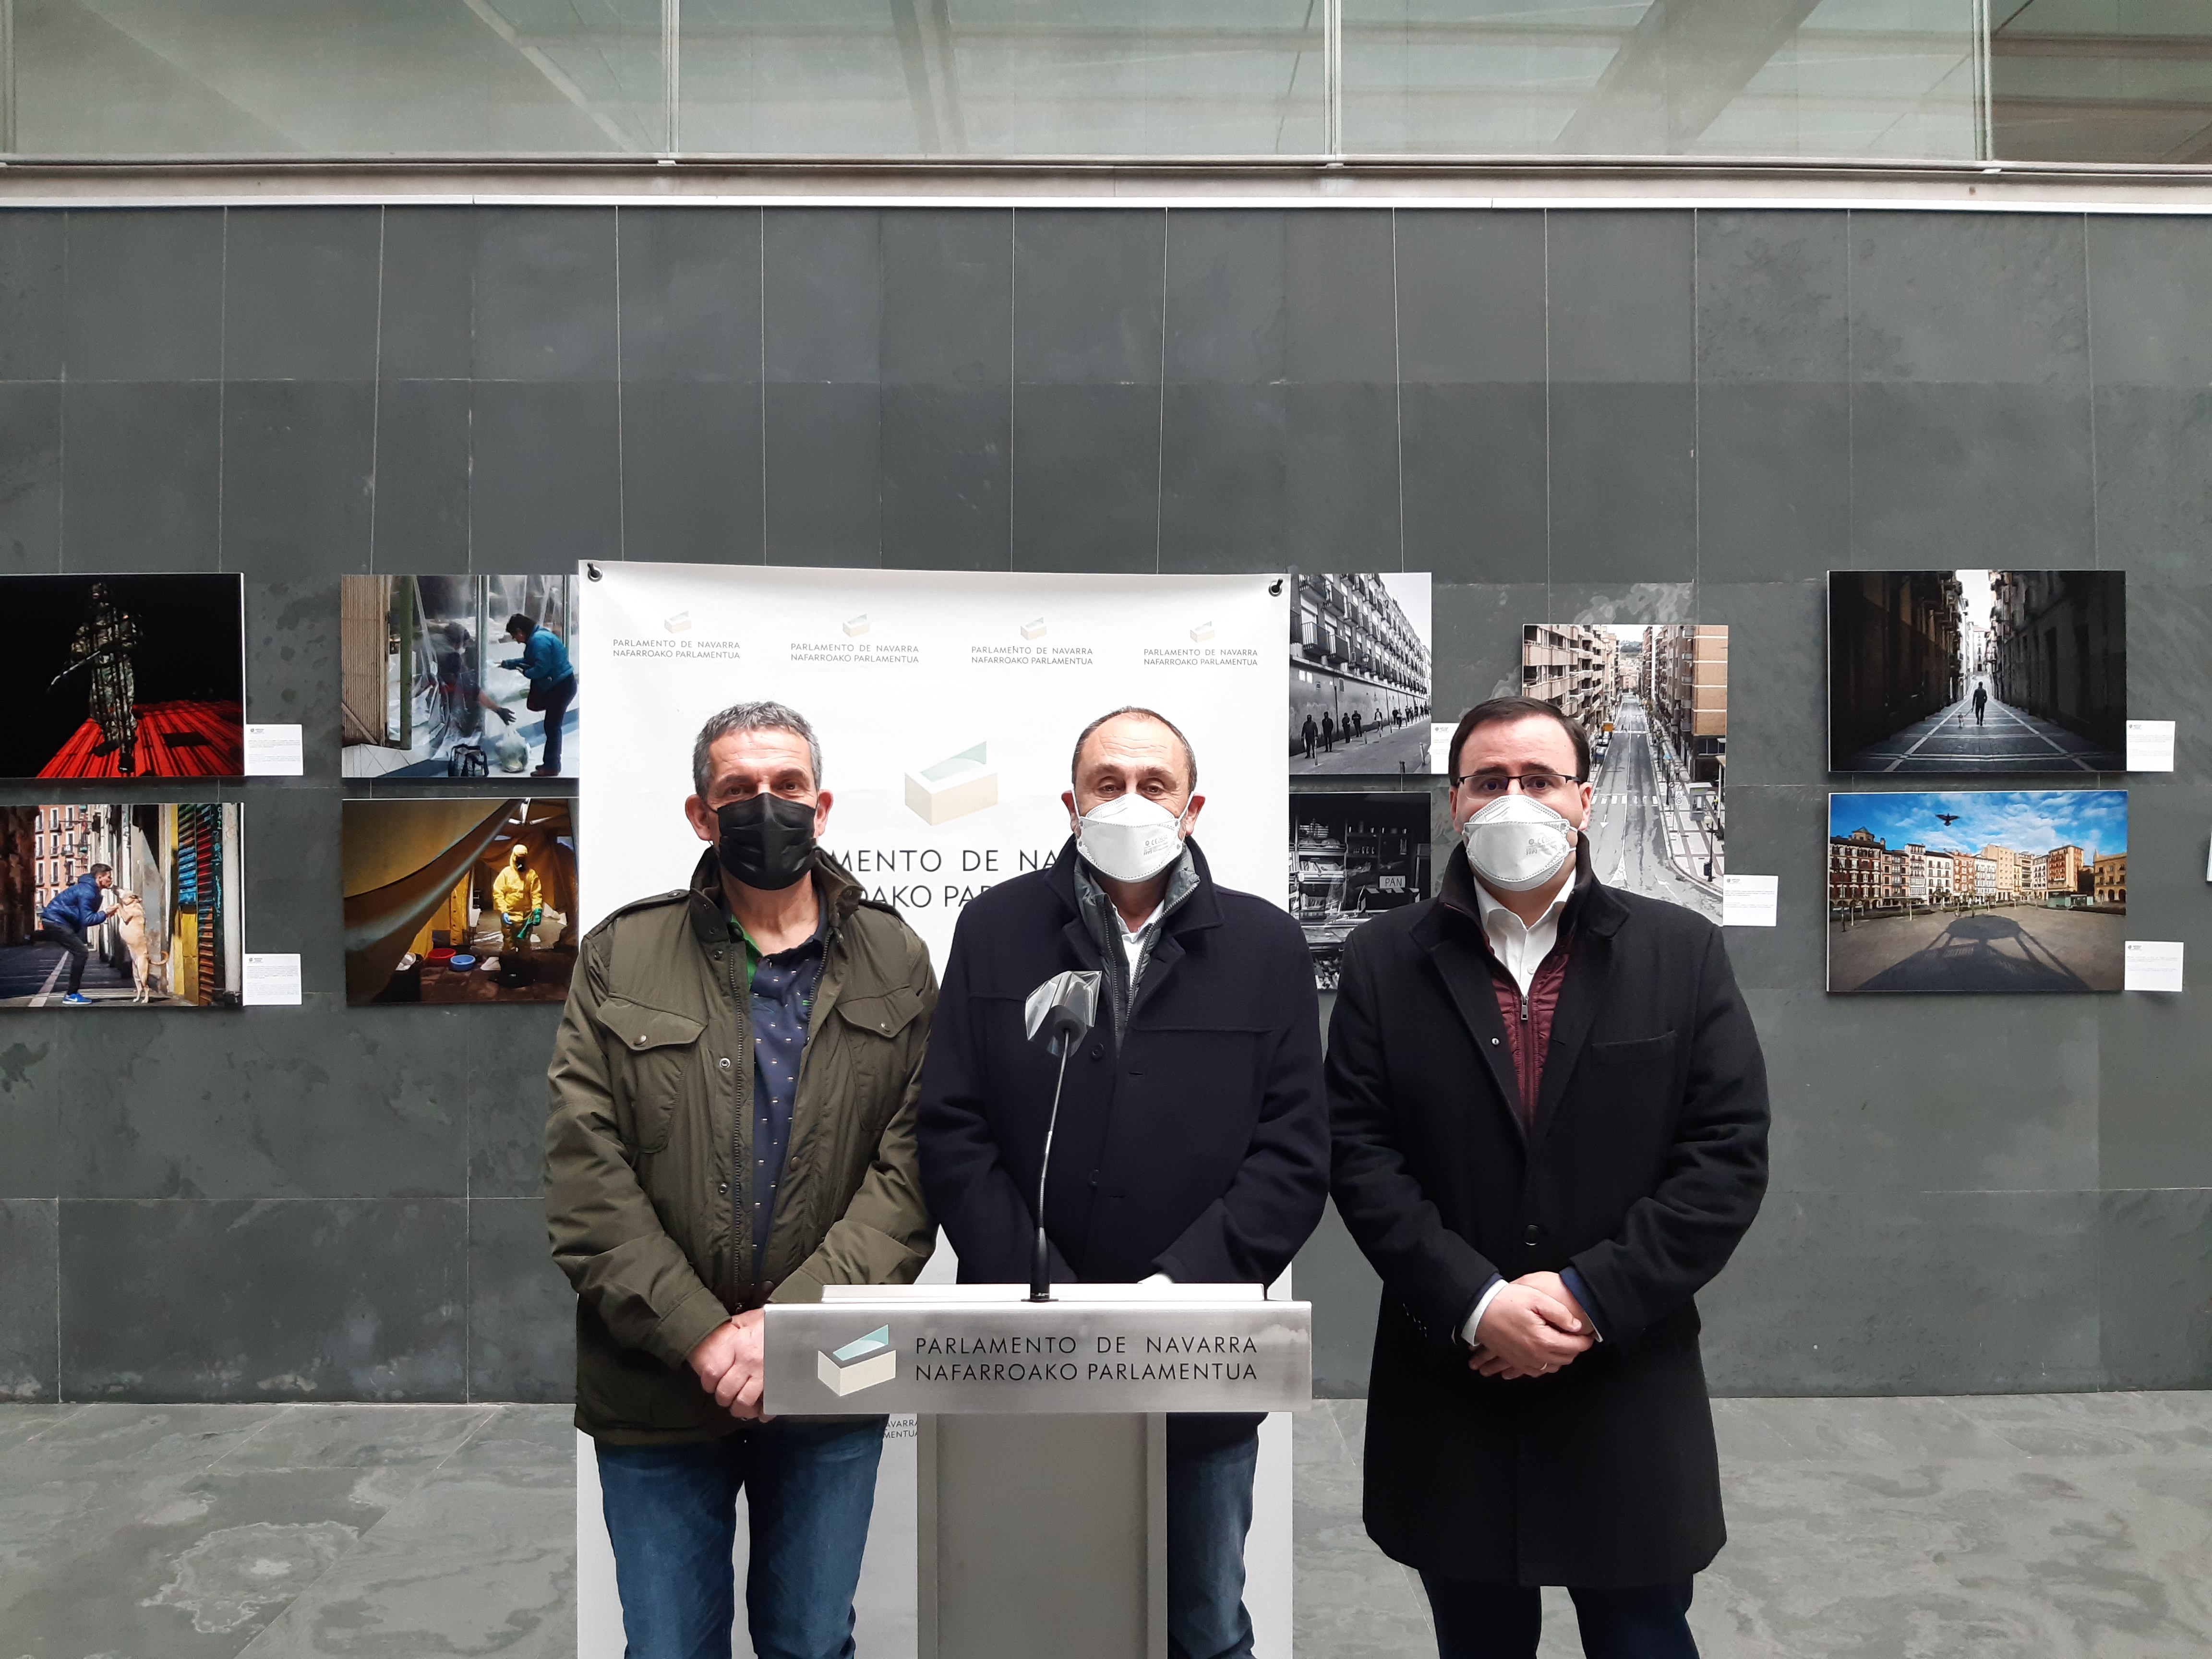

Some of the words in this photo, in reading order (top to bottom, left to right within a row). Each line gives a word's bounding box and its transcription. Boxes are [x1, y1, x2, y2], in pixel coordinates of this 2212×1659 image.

[613, 639, 675, 648] PARLAMENTO
[791, 643, 854, 651] PARLAMENTO
[613, 649, 673, 658] NAFARROAKO
[791, 654, 851, 662] NAFARROAKO
[854, 655, 919, 663] PARLAMENTUA
[831, 849, 942, 872] MENTO
[963, 850, 998, 871] DE
[1020, 849, 1057, 871] NA
[1385, 878, 1402, 887] PAN
[916, 1336, 1077, 1354] PARLAMENTO
[1097, 1336, 1126, 1353] DE
[1147, 1336, 1257, 1353] NAVARRA
[916, 1363, 1078, 1381] NAFARROAKO
[1088, 1362, 1257, 1381] PARLAMENTUA
